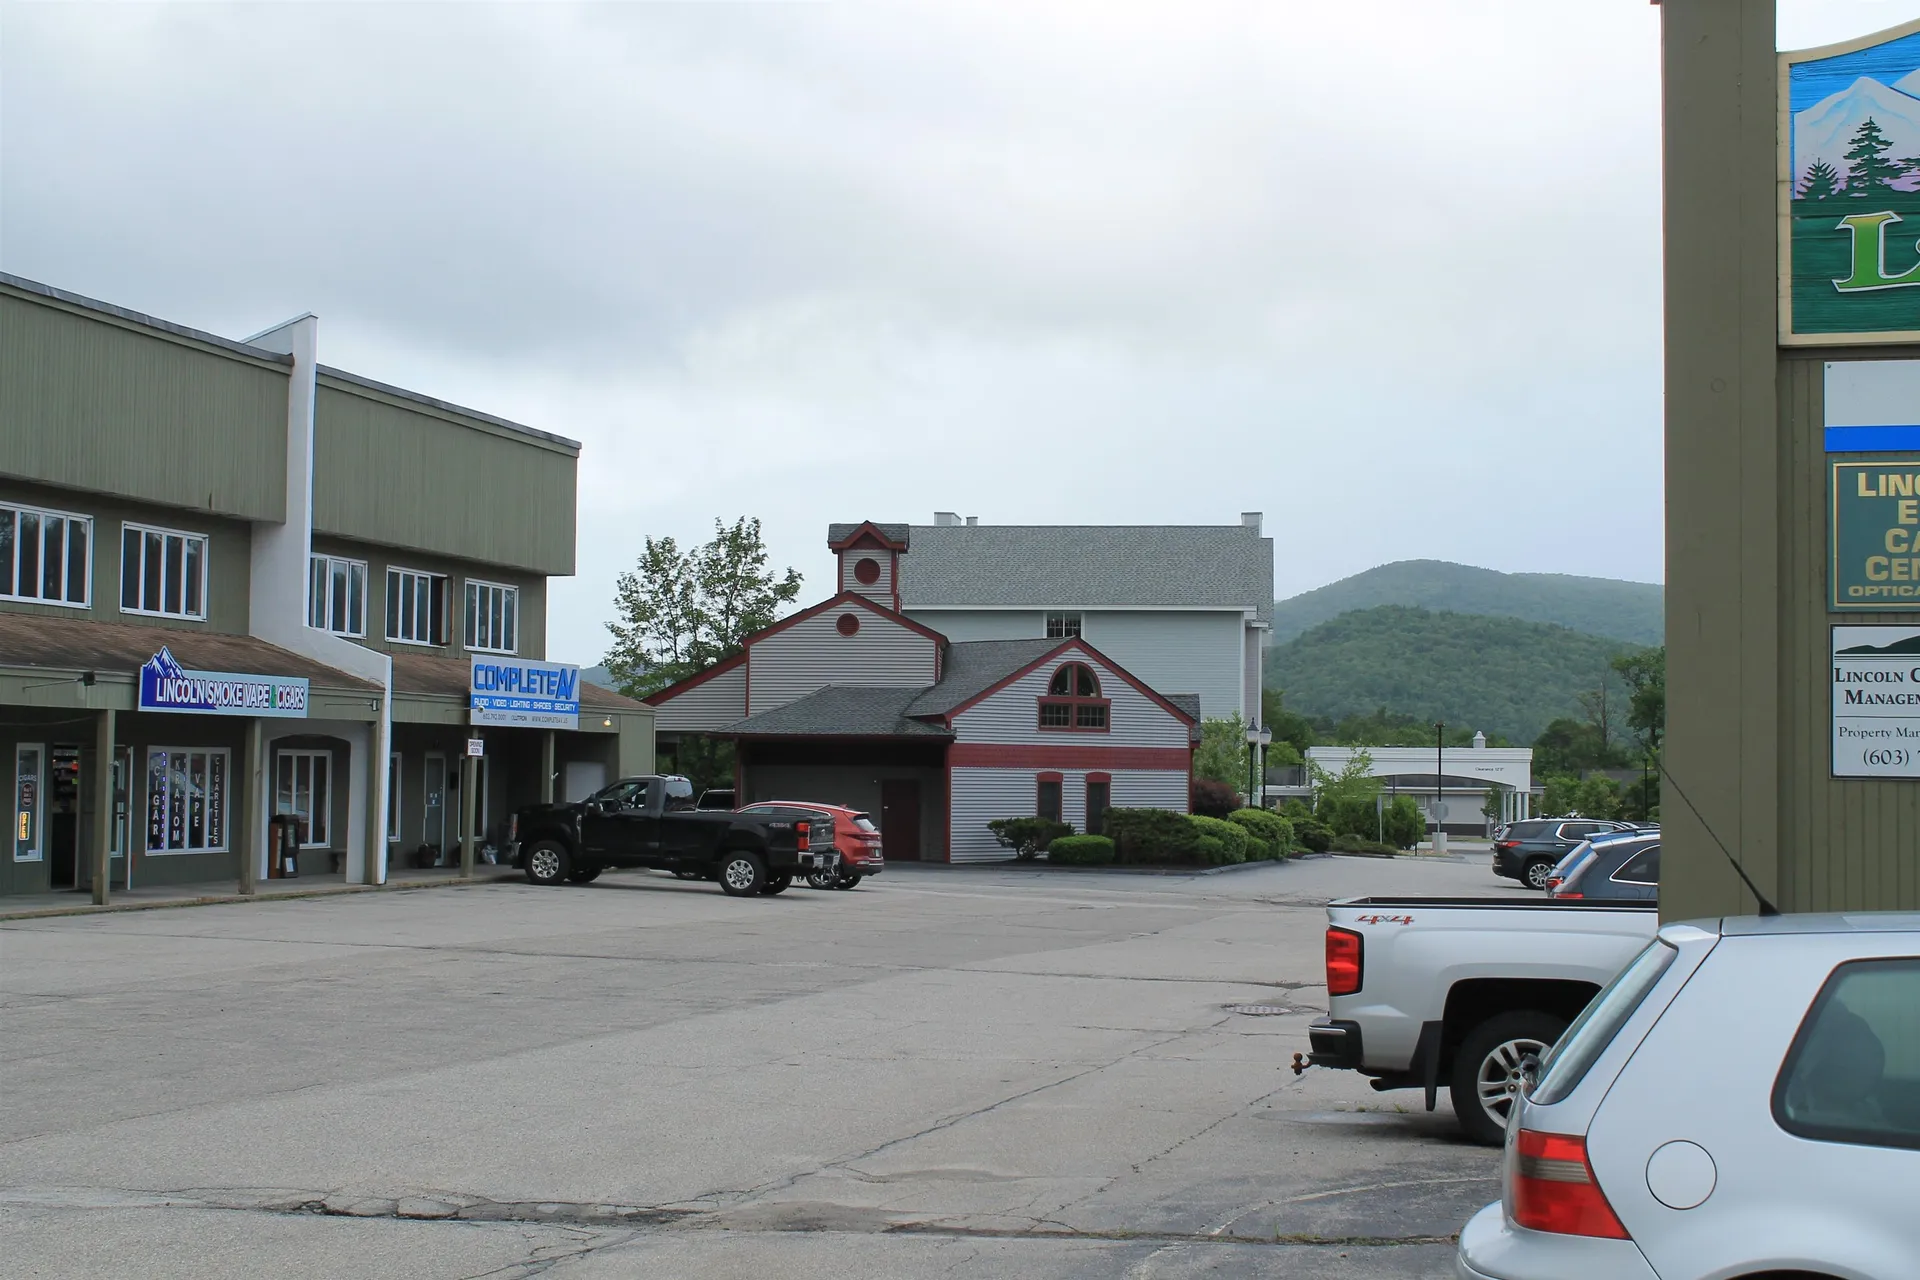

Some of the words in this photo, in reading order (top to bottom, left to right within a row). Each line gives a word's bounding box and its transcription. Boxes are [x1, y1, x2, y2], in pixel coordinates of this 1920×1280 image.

[1831, 210, 1920, 293] L
[1857, 472, 1920, 497] LIN
[1848, 585, 1920, 597] OPTIC
[156, 677, 206, 706] LINCOLN
[207, 681, 244, 708] SMOKE
[243, 683, 271, 710] VAPE
[270, 685, 278, 709] &
[277, 685, 306, 711] CIGARS
[473, 697, 490, 707] AUDIO
[492, 699, 508, 708] VIDEO
[509, 700, 531, 710] LIGHTING
[532, 701, 552, 711] SHADES
[554, 703, 576, 713] SECURITY
[1839, 726, 1892, 739] Property
[1863, 748, 1909, 767] (603)
